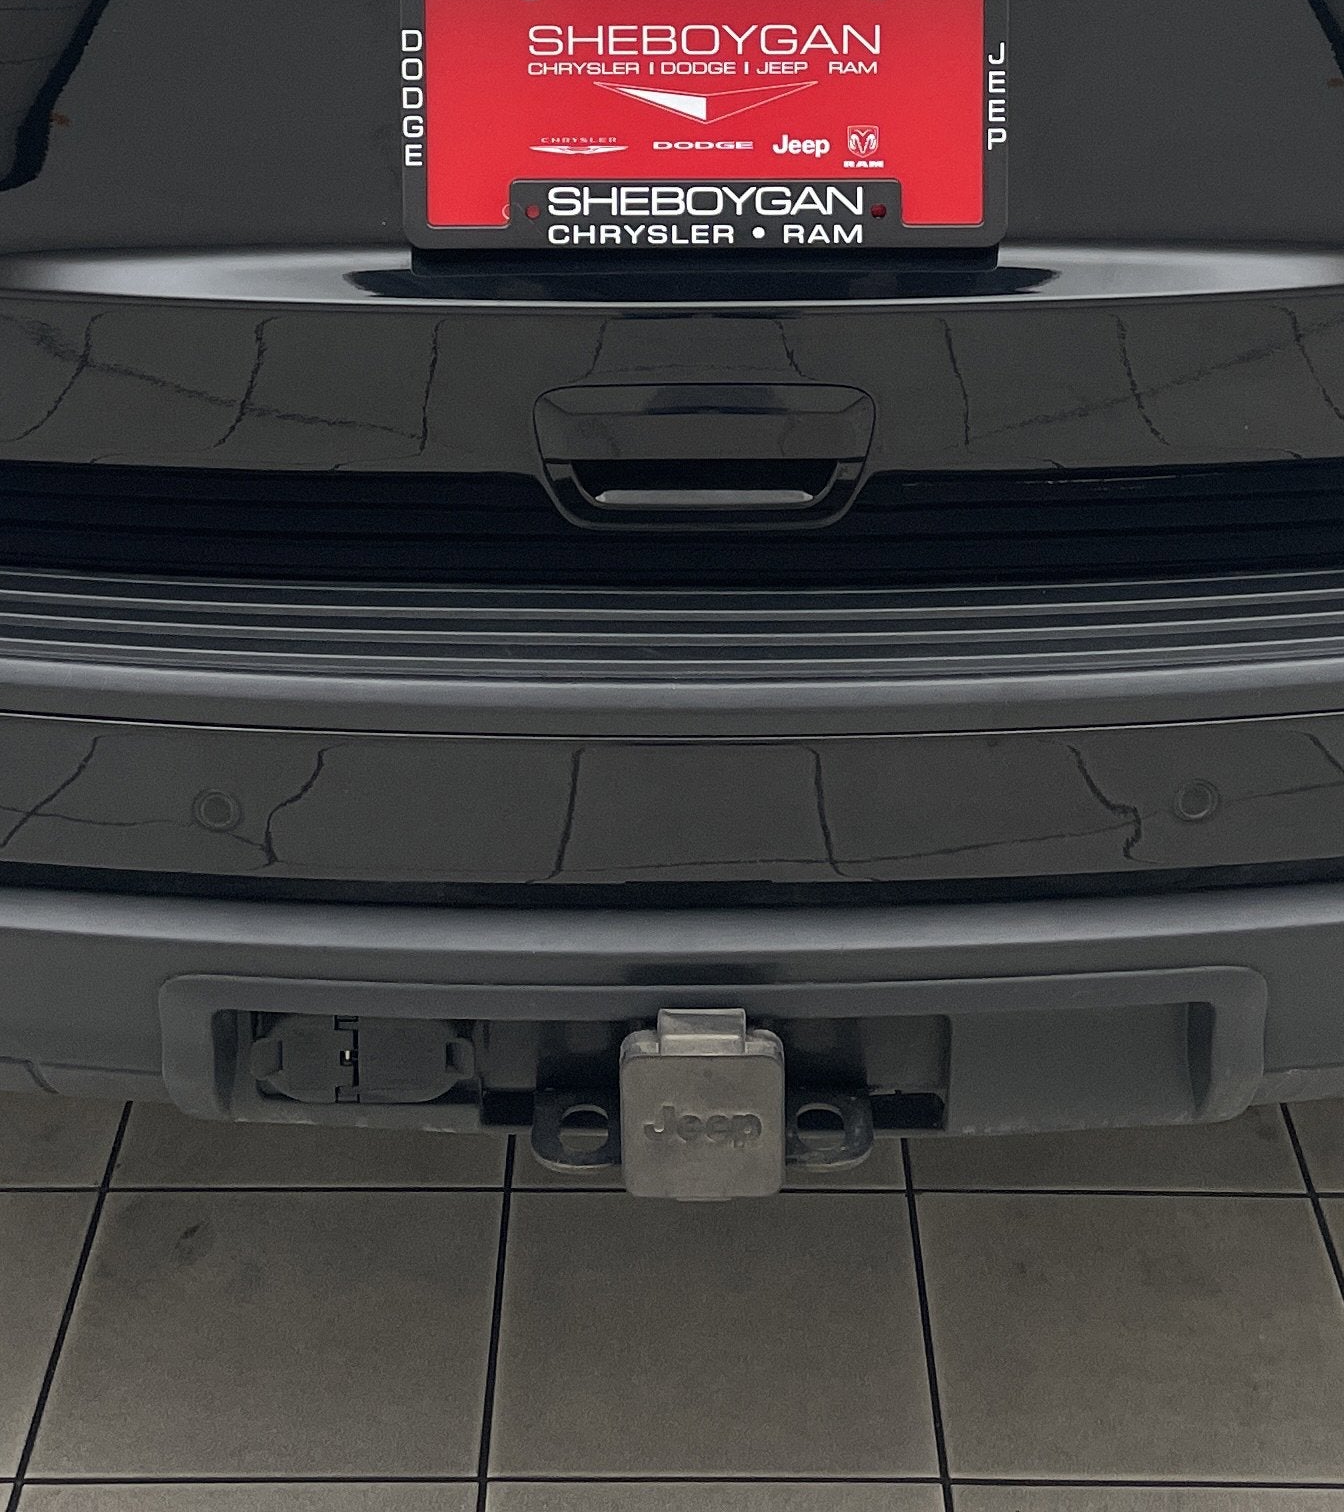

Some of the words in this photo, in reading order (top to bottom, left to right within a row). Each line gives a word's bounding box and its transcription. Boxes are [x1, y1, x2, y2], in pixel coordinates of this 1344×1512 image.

[527, 24, 882, 56] SHEBOYGAN
[527, 61, 640, 76] CHRYSLER
[660, 61, 736, 76] DODGE
[756, 61, 808, 76] JEEP
[828, 61, 878, 76] RAM
[401, 29, 424, 167] DODGE
[987, 41, 1007, 150] JEEP
[652, 141, 754, 151] DODGE
[771, 134, 830, 157] Jeep
[843, 160, 885, 168] RAM
[547, 186, 863, 217] SHEBOYGAN
[548, 225, 734, 245] CHRYSLER
[783, 225, 863, 245] RAM
[644, 1104, 763, 1148] Jeep
